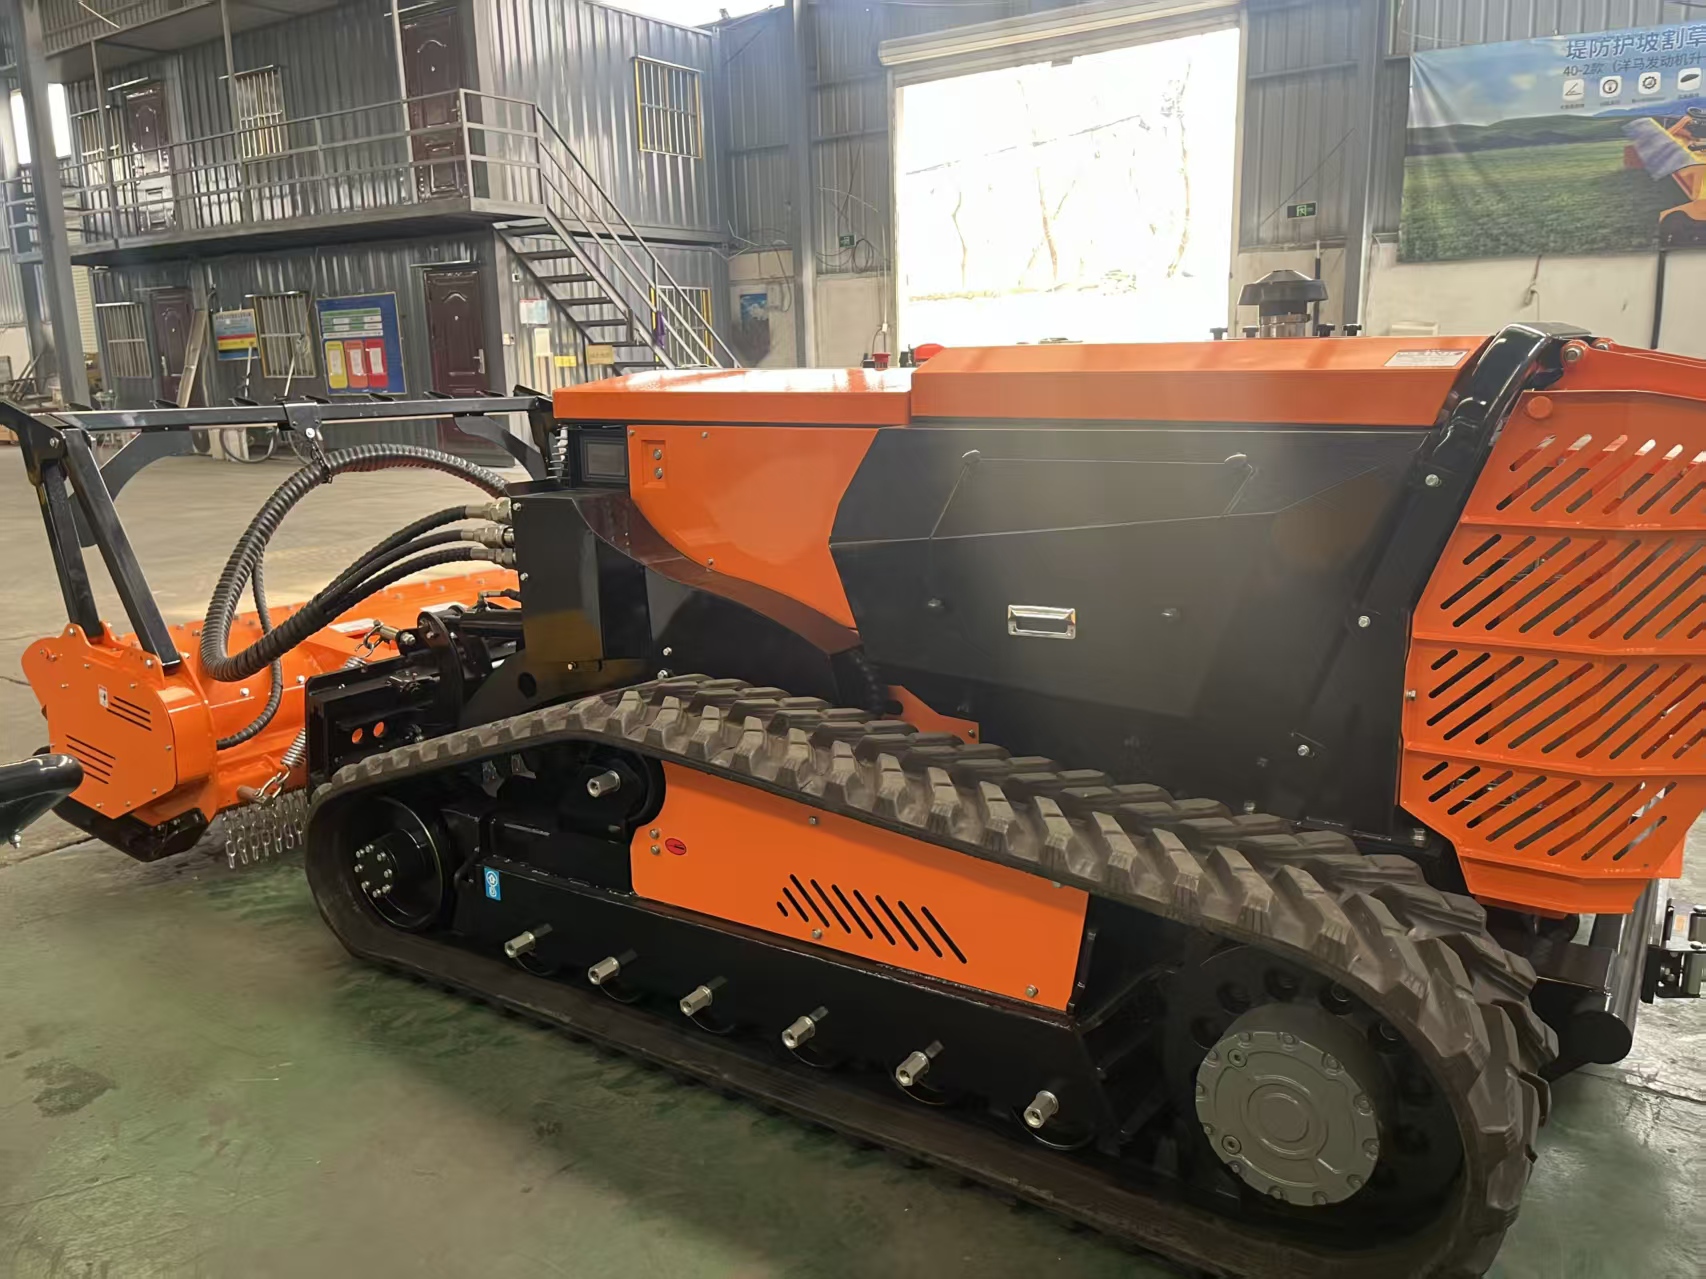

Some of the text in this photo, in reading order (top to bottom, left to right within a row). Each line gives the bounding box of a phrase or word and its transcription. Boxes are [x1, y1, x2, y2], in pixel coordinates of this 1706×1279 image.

[1566, 25, 1706, 60] 堤防护坡割草
